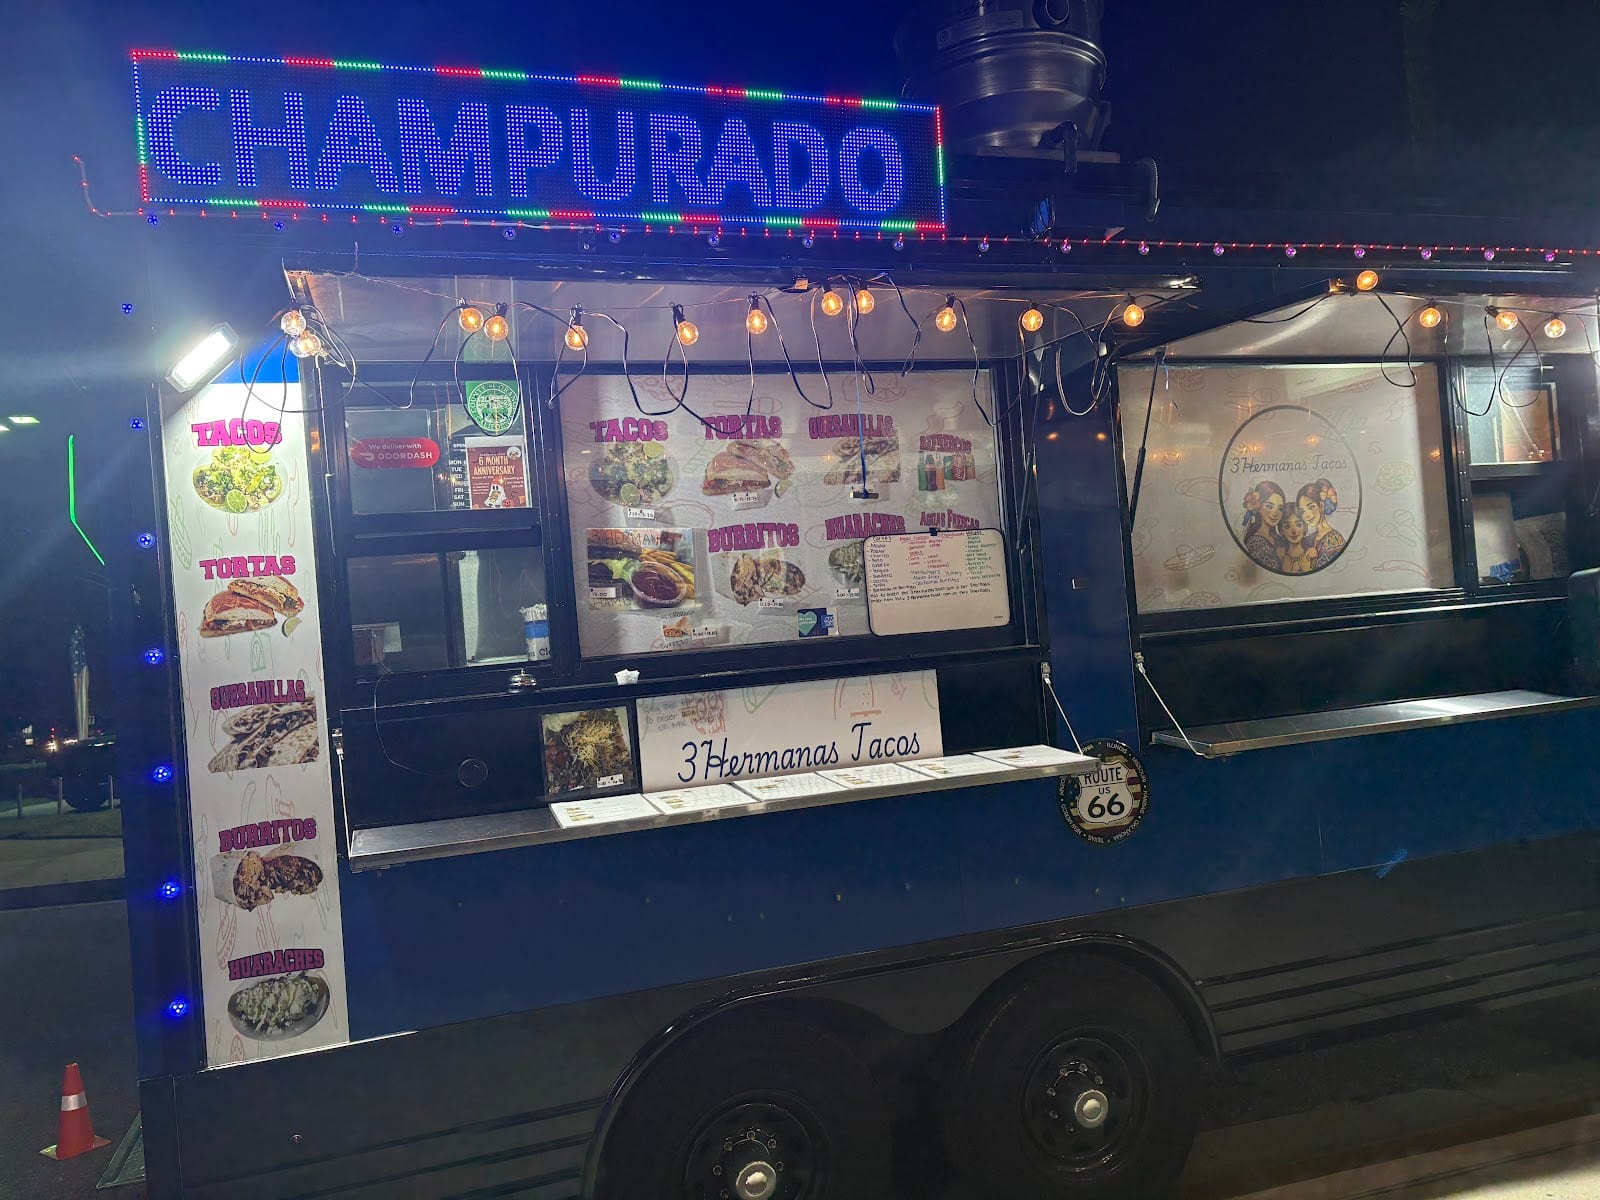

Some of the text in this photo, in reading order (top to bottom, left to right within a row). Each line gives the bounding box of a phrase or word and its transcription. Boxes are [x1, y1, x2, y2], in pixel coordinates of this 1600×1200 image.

[147, 85, 905, 214] CHAMPURADO
[191, 418, 283, 447] TACOS
[590, 417, 669, 443] TACOS
[701, 414, 782, 440] TORTAS
[808, 413, 894, 440] QUESADILLAS
[378, 451, 433, 460] DOORDASH
[478, 455, 509, 466] 6 MONTH
[1230, 454, 1348, 474] 3 Hermanas Tacos
[474, 465, 515, 476] ANNIVERSARY
[707, 523, 800, 552] BURRITOS
[824, 512, 906, 541] HUARACHES
[199, 555, 296, 580] TORTAS
[210, 680, 306, 710] QUESADILLAS
[677, 721, 921, 783] 3 Hermanas Tacos
[1106, 742, 1128, 754] ILLINOIS
[1085, 766, 1123, 785] ROUTE
[1098, 786, 1111, 795] US
[1087, 792, 1125, 819] 66
[218, 818, 317, 853] BURRITOS
[228, 948, 325, 981] HUARACHES
